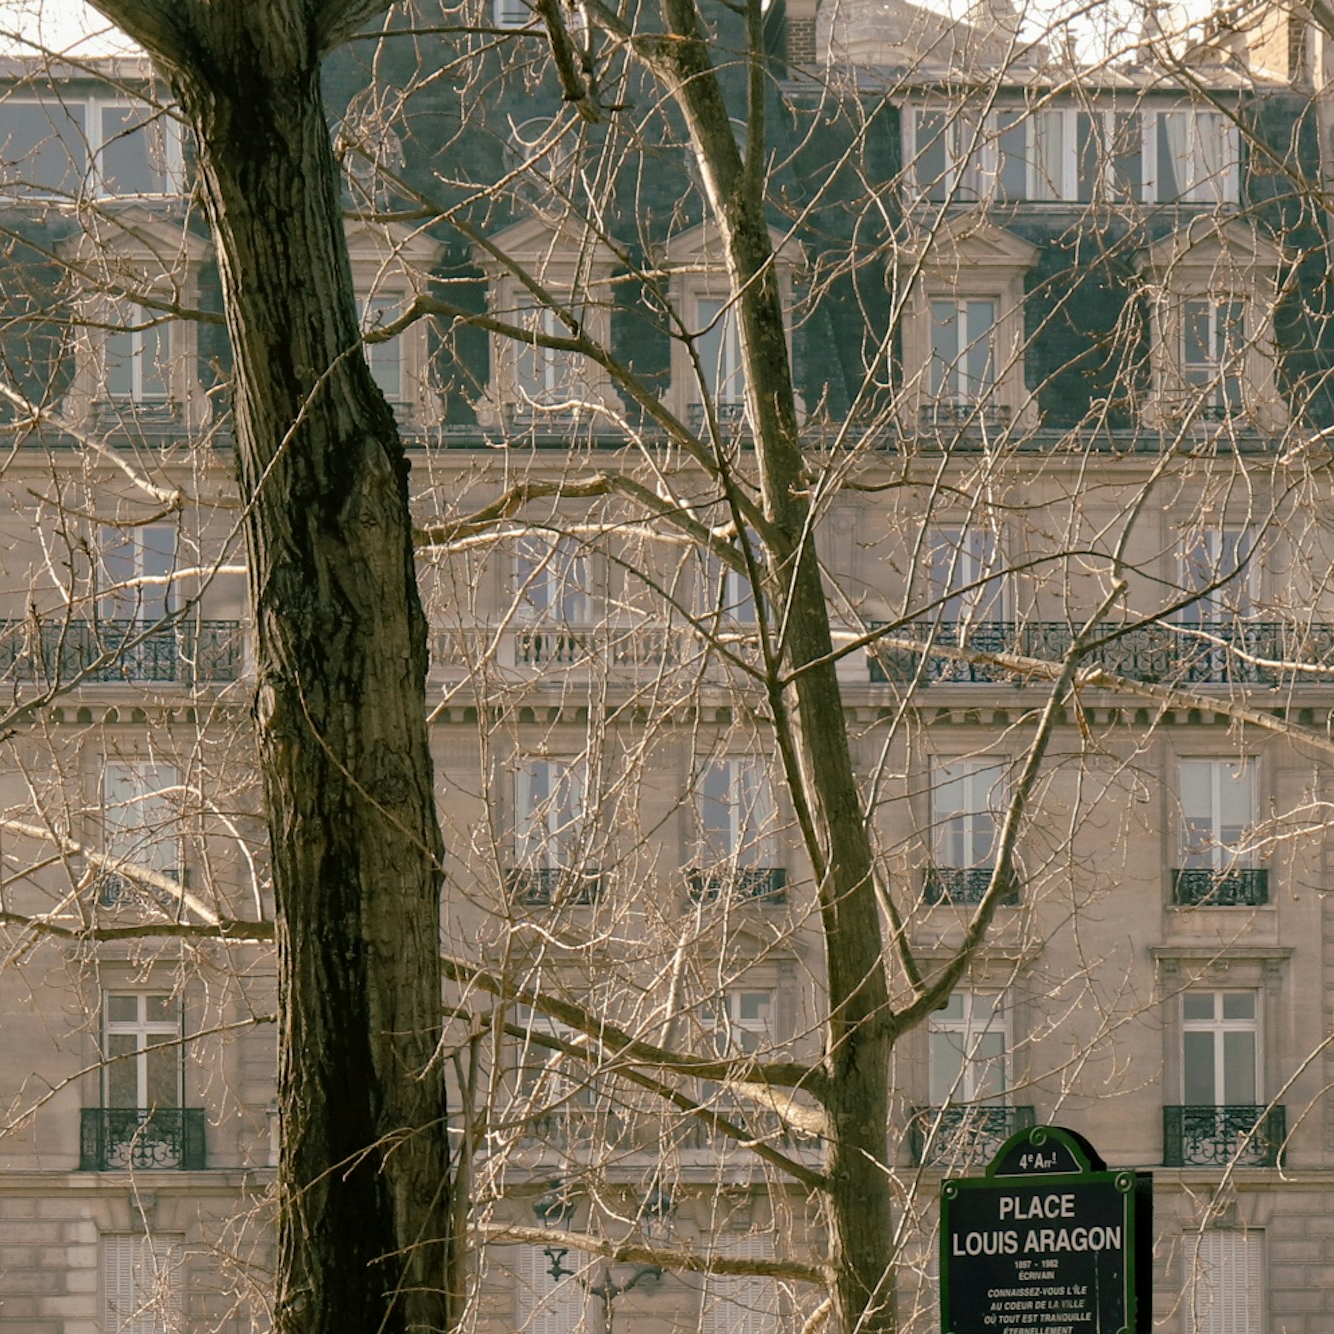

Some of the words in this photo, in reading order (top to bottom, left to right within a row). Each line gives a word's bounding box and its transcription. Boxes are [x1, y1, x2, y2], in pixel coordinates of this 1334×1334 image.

[999, 1194, 1075, 1220] PLACE
[953, 1230, 1018, 1256] LOUIS
[1023, 1226, 1121, 1253] ARAGON
[1018, 1270, 1055, 1281] ÉCRIVAIN
[987, 1285, 1065, 1298] CONNAISSEZ-VOUS
[990, 1301, 1002, 1311] AU
[1004, 1300, 1033, 1311] COEUR
[1035, 1300, 1047, 1310] DE
[1048, 1300, 1059, 1309] LA
[1061, 1299, 1085, 1309] VILLE
[984, 1313, 997, 1325] OÙ
[998, 1313, 1020, 1324] TOUT
[1021, 1313, 1039, 1323] EST
[1040, 1311, 1092, 1322] TRANQUILLE
